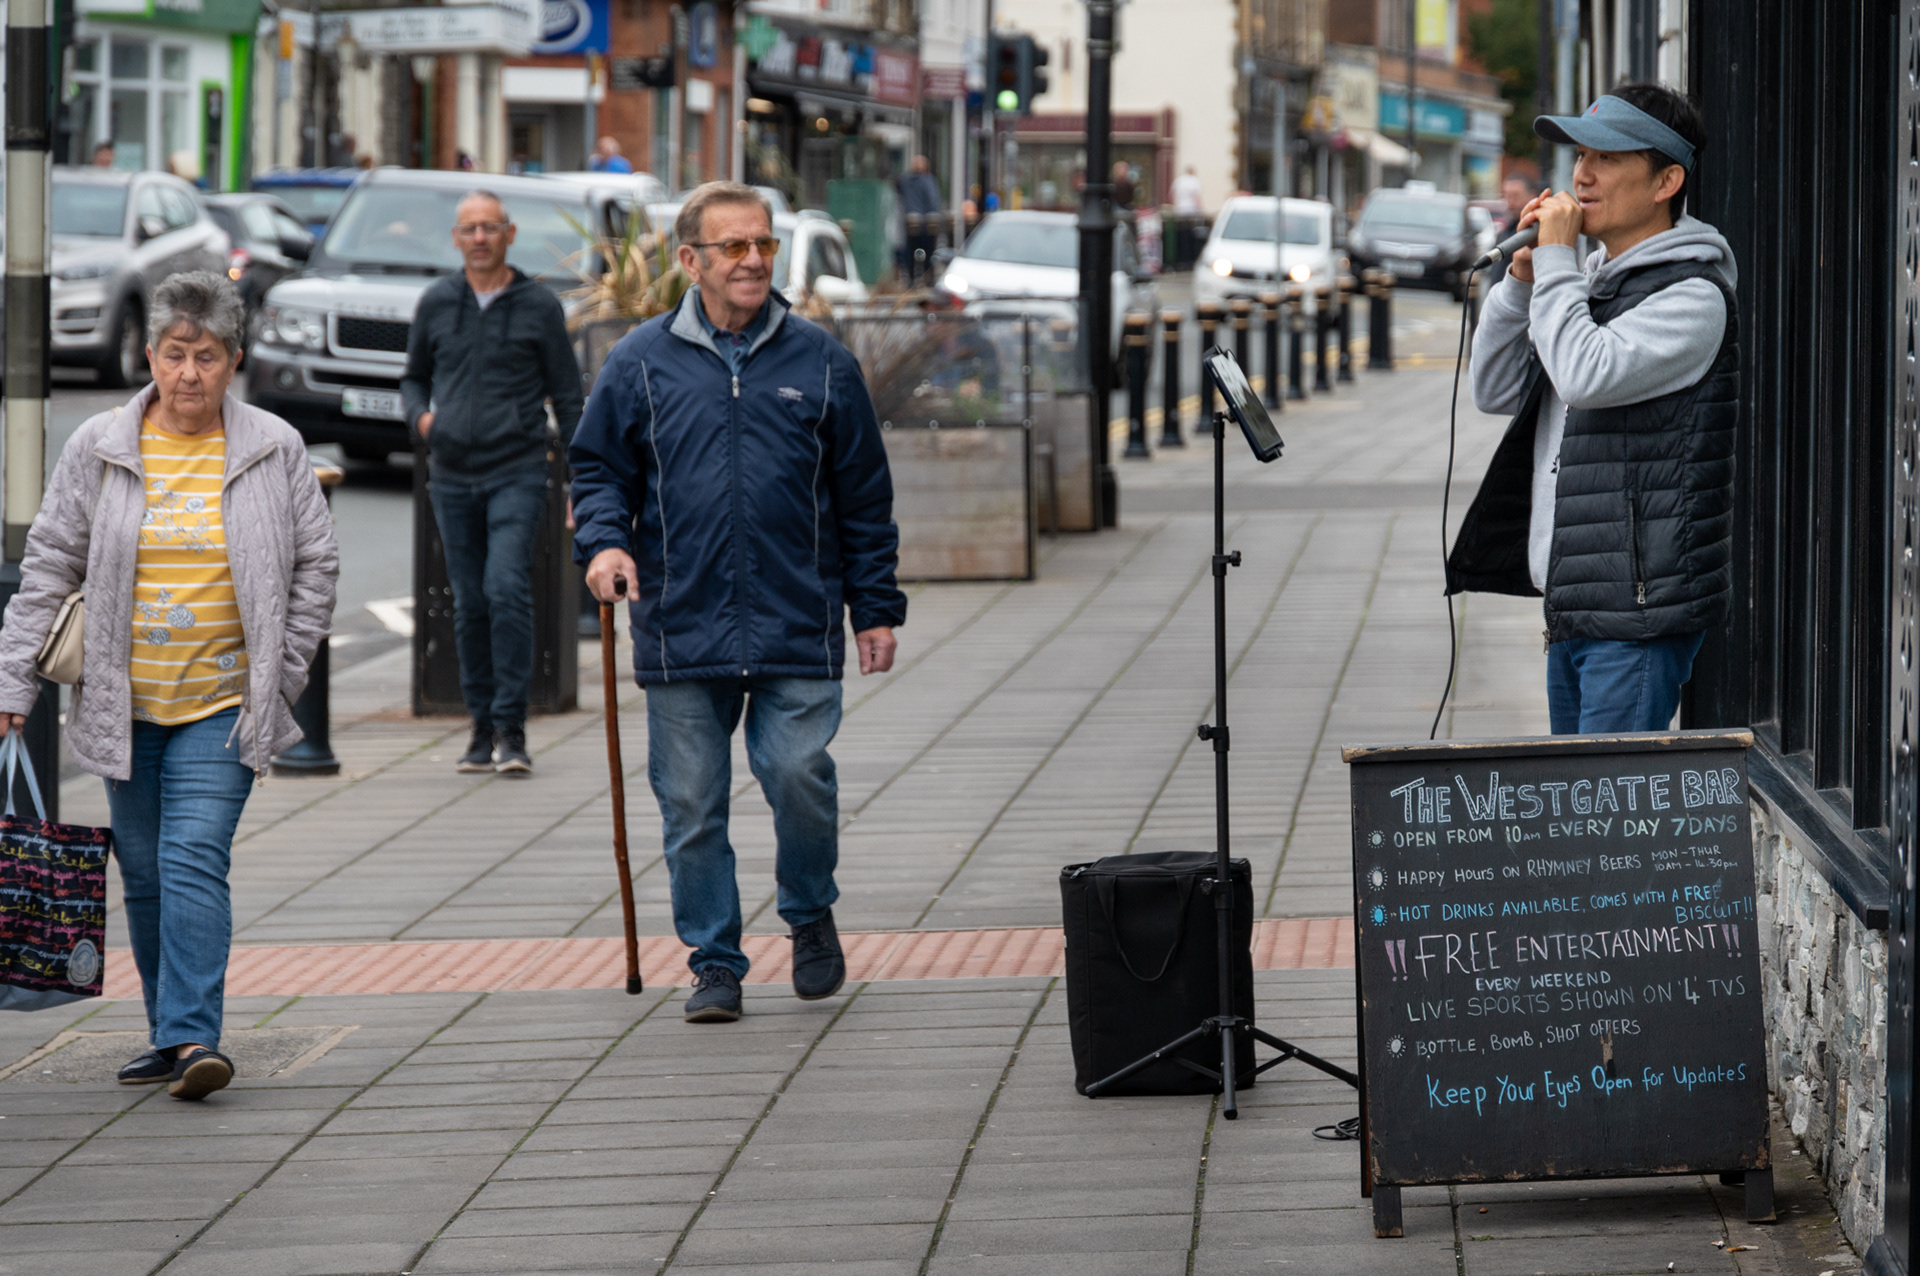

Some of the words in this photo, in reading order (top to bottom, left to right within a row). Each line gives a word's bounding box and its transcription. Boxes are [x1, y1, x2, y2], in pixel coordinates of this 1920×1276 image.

[1390, 777, 1451, 823] THE
[1454, 771, 1670, 822] WESTGATE
[1681, 767, 1743, 808] BAR
[1393, 831, 1436, 848] OPEN
[1446, 826, 1493, 844] FROM
[1549, 817, 1613, 838] EVERY
[1623, 818, 1660, 838] DAY
[1397, 870, 1445, 887] HAPPY
[1502, 866, 1520, 878] ON
[1527, 858, 1591, 878] RHYMNEY
[1600, 854, 1642, 871] BEERS
[1399, 904, 1431, 922] HOT
[1442, 902, 1495, 921] DRINKS
[1590, 892, 1627, 909] COMES
[1633, 891, 1666, 905] WITH
[1671, 888, 1679, 903] A
[1684, 884, 1721, 902] FREE
[1475, 977, 1521, 991] EVERY
[1530, 970, 1611, 989] WEEKEND
[1407, 999, 1456, 1022] LIVE
[1467, 993, 1550, 1016] SPORTS
[1560, 985, 1635, 1011] SHOWN
[1643, 982, 1672, 1003] ON
[1546, 1023, 1581, 1043] SHOT
[1590, 1019, 1641, 1036] OFFERS
[1426, 1073, 1487, 1117] Keep
[1495, 1074, 1536, 1105] Your
[1591, 1065, 1633, 1096] Open
[1642, 1066, 1664, 1091] for
